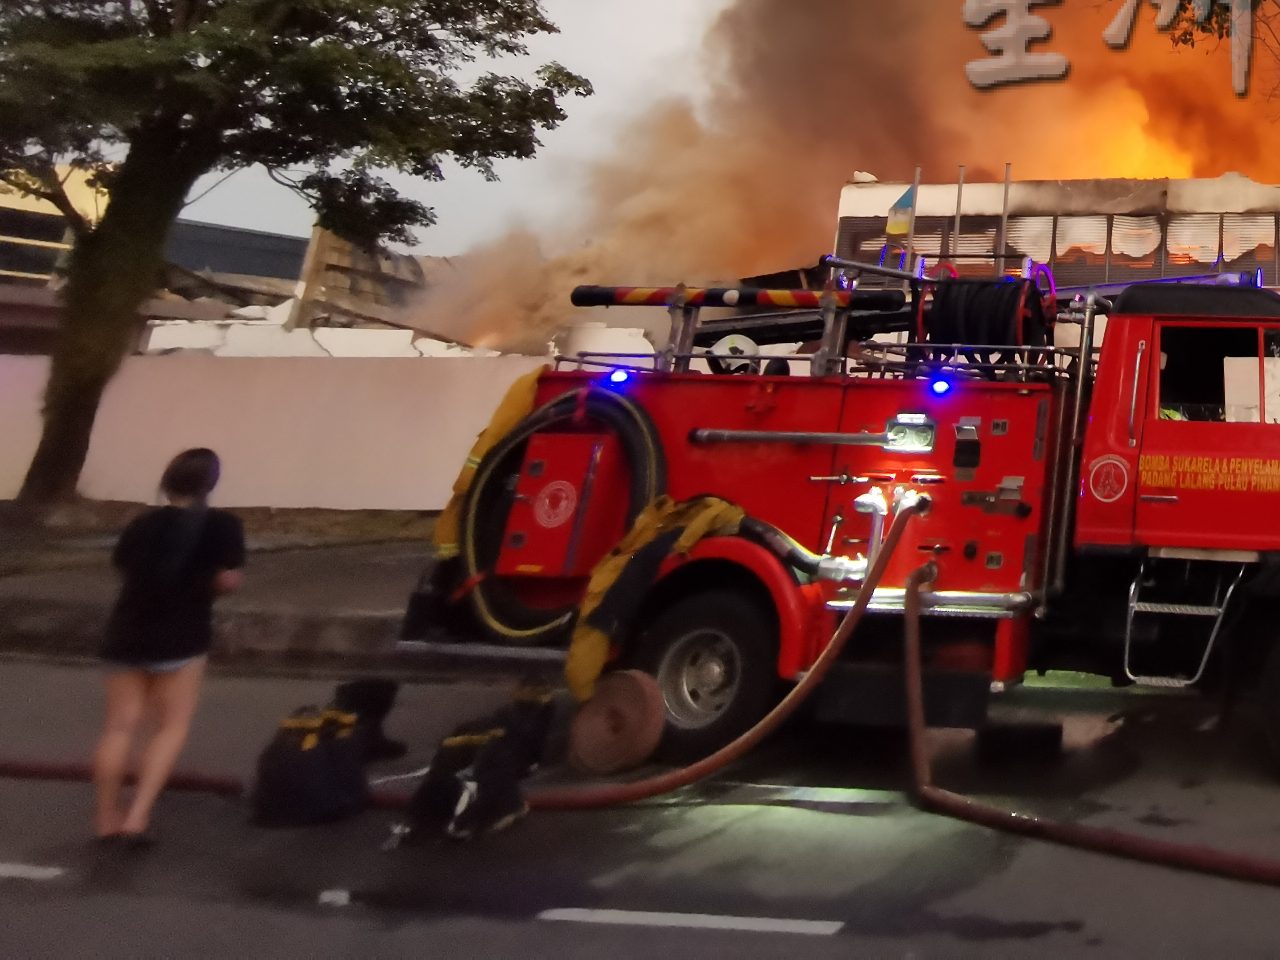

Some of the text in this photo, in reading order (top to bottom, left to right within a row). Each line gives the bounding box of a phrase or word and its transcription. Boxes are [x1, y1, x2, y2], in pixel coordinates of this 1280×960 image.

[1139, 455, 1170, 472] BOMBA
[1173, 456, 1219, 473] SUKARELA
[1141, 470, 1177, 488] PADANG
[1179, 472, 1215, 489] LALANG
[1218, 473, 1248, 490] PULAU
